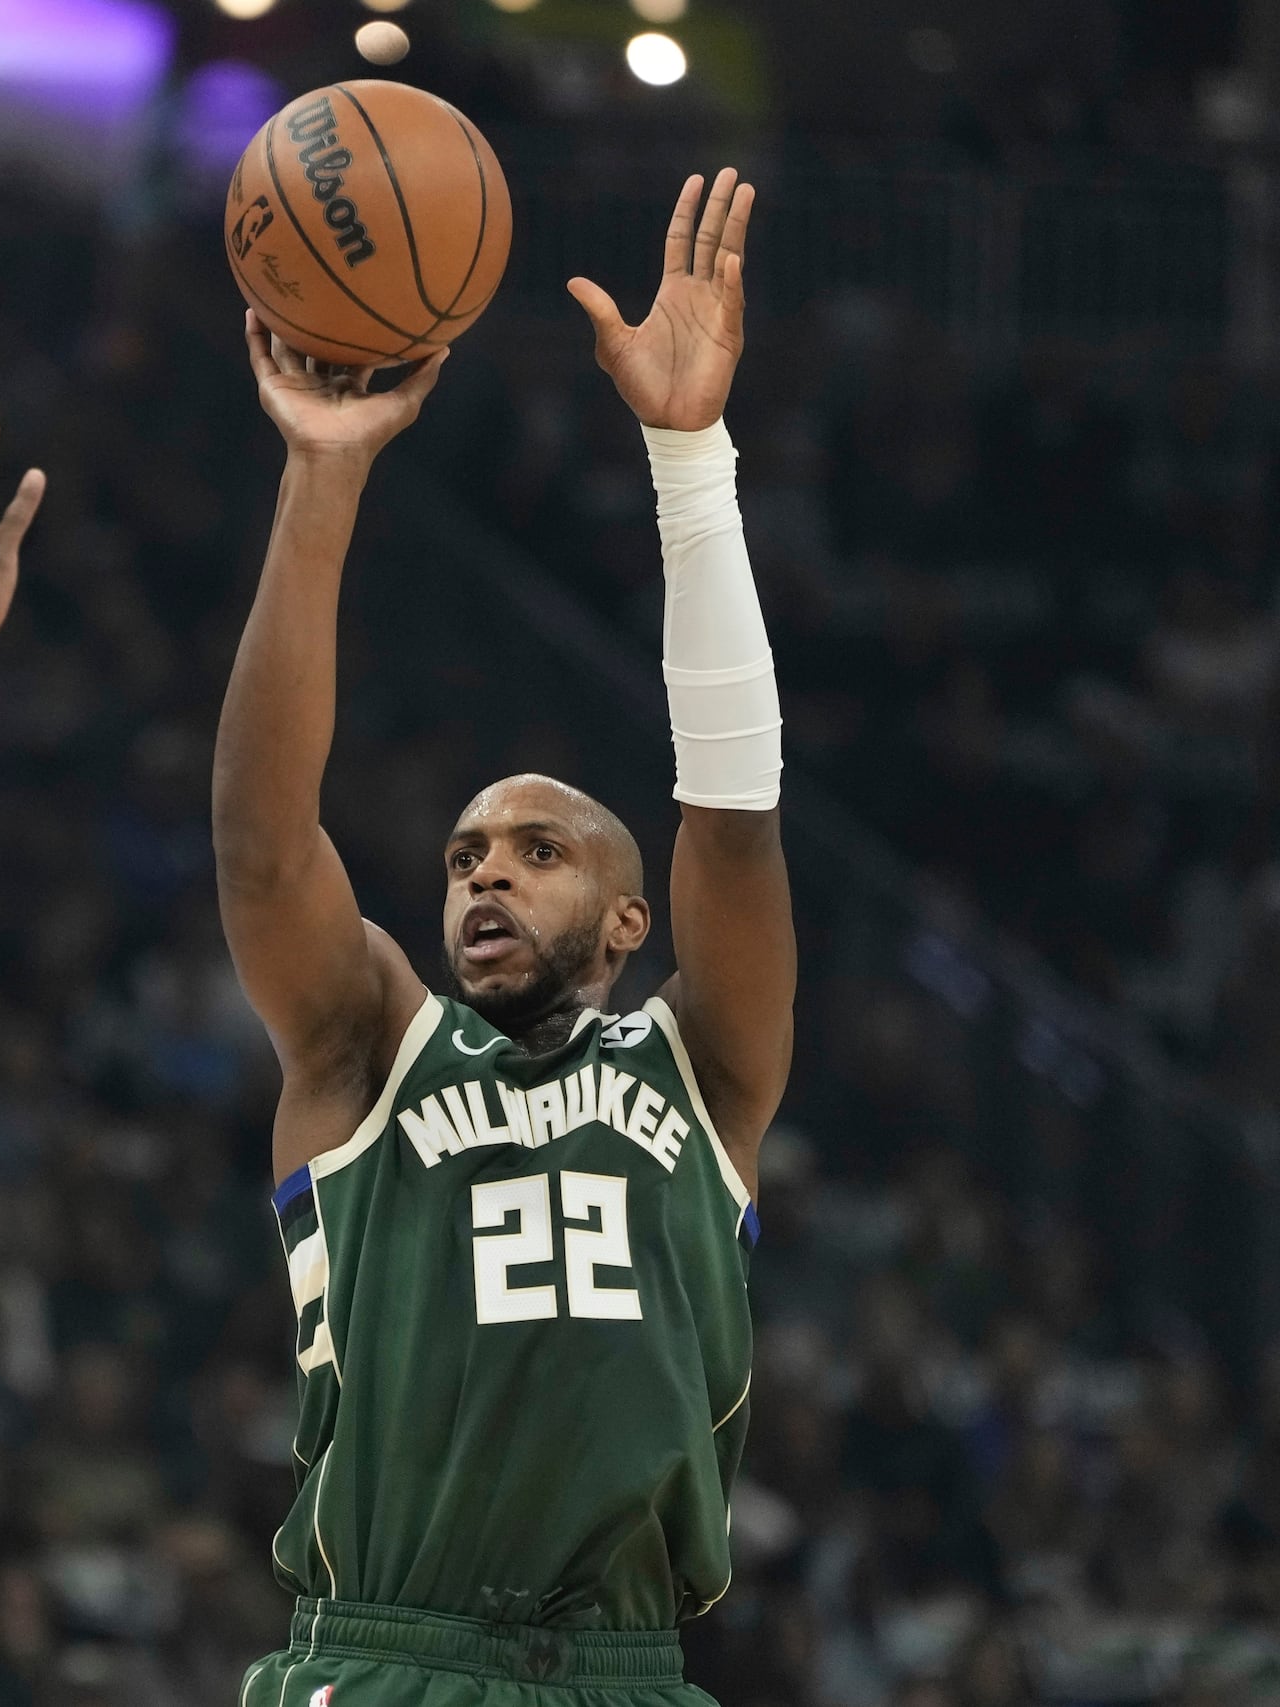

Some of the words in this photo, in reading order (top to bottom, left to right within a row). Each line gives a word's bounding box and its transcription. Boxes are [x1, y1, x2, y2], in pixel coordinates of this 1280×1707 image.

[286, 96, 377, 269] Wilson
[397, 1063, 691, 1174] MILWAUKEE
[471, 1170, 643, 1325] 22
